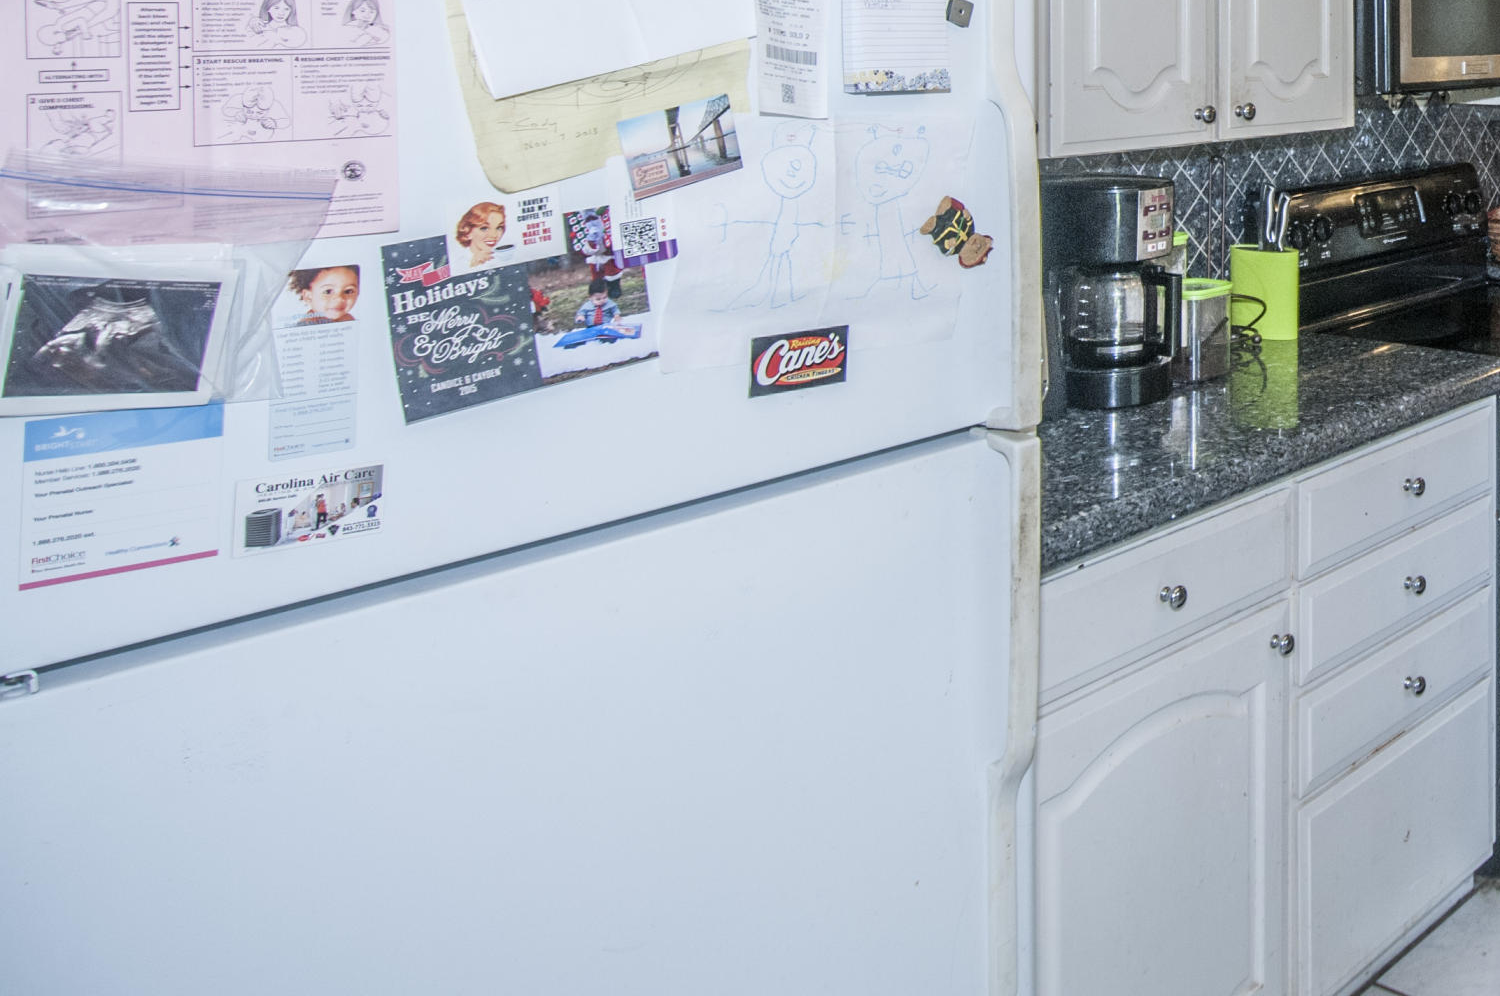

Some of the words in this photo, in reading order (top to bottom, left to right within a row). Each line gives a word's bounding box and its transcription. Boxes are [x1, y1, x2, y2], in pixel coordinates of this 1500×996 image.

[522, 196, 549, 207] HAVEN'T
[517, 211, 540, 222] COFFEE
[527, 221, 546, 230] DON'T
[522, 229, 541, 238] MAKE
[523, 237, 538, 245] KILL
[539, 234, 552, 242] YOU
[392, 276, 489, 314] Holidays
[407, 312, 430, 324] BE
[421, 305, 480, 334] Merry
[413, 335, 435, 356] &
[431, 324, 514, 364] Bright
[790, 338, 821, 350] Raising
[757, 332, 844, 386] Cane's
[787, 372, 810, 381] CHICKEN
[255, 478, 314, 494] Carolina
[318, 473, 340, 485] Air
[344, 468, 375, 481] Care
